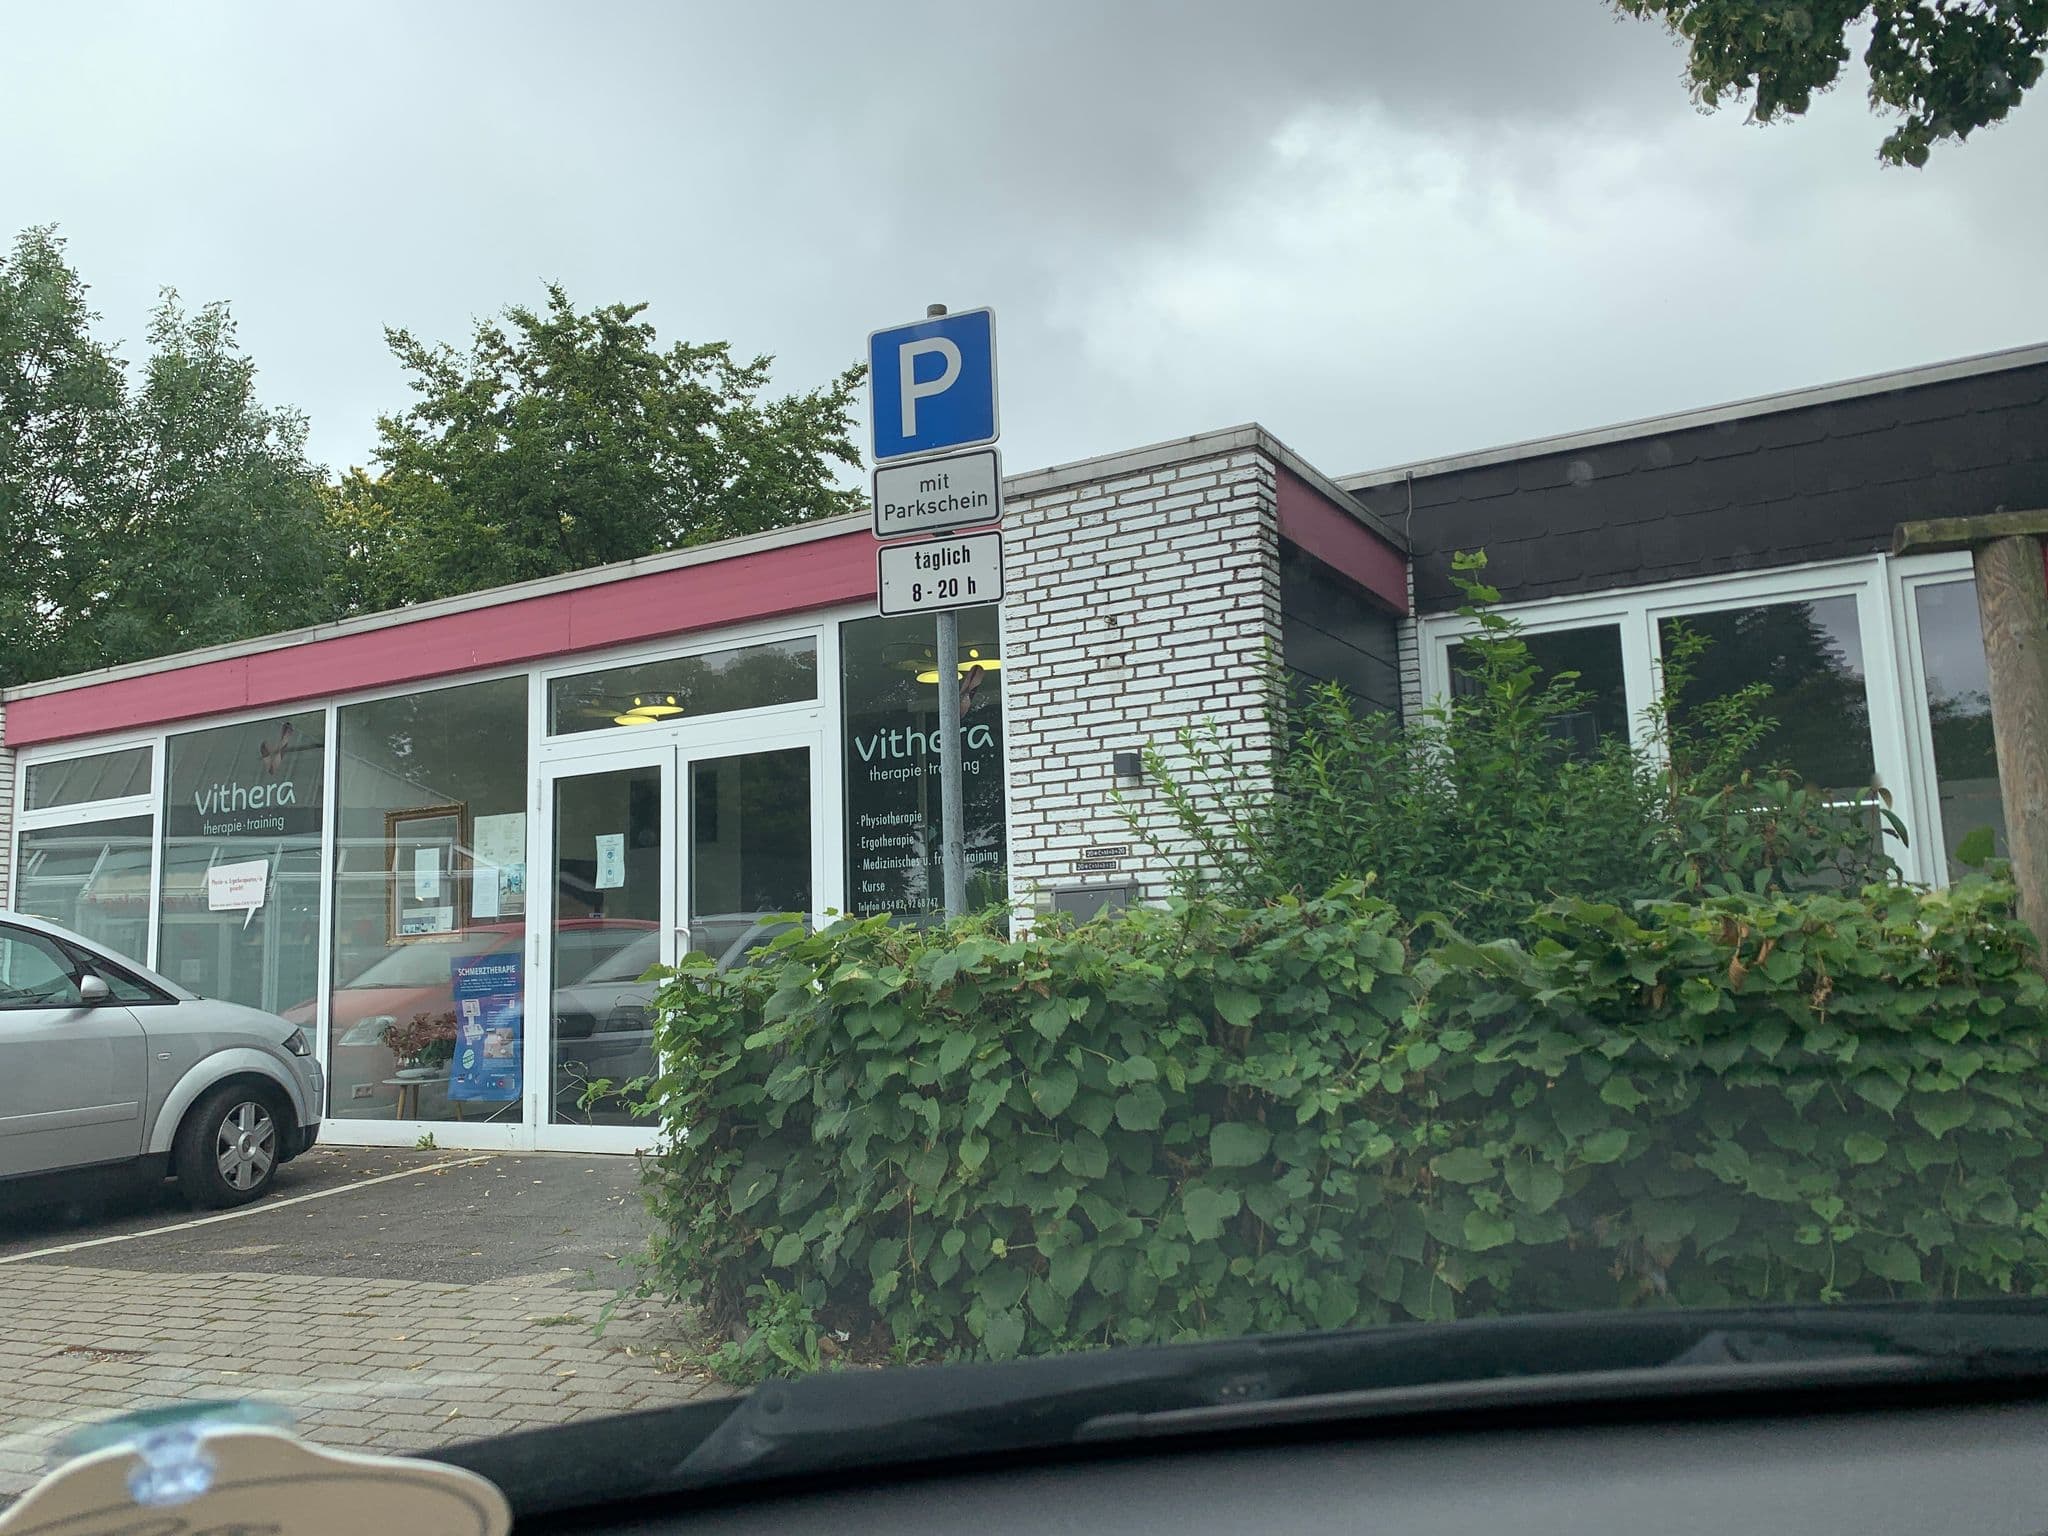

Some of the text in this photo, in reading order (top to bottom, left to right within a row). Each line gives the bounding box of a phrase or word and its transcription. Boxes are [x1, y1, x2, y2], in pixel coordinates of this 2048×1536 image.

[899, 336, 962, 438] P
[919, 473, 950, 493] mit
[884, 491, 988, 521] Parkschein
[914, 545, 971, 571] täglich
[967, 576, 977, 595] h
[860, 810, 922, 829] Physiotherapie
[861, 833, 914, 851] Ergotherapie
[863, 854, 920, 871] Medizinisches
[862, 880, 886, 893] Kurse
